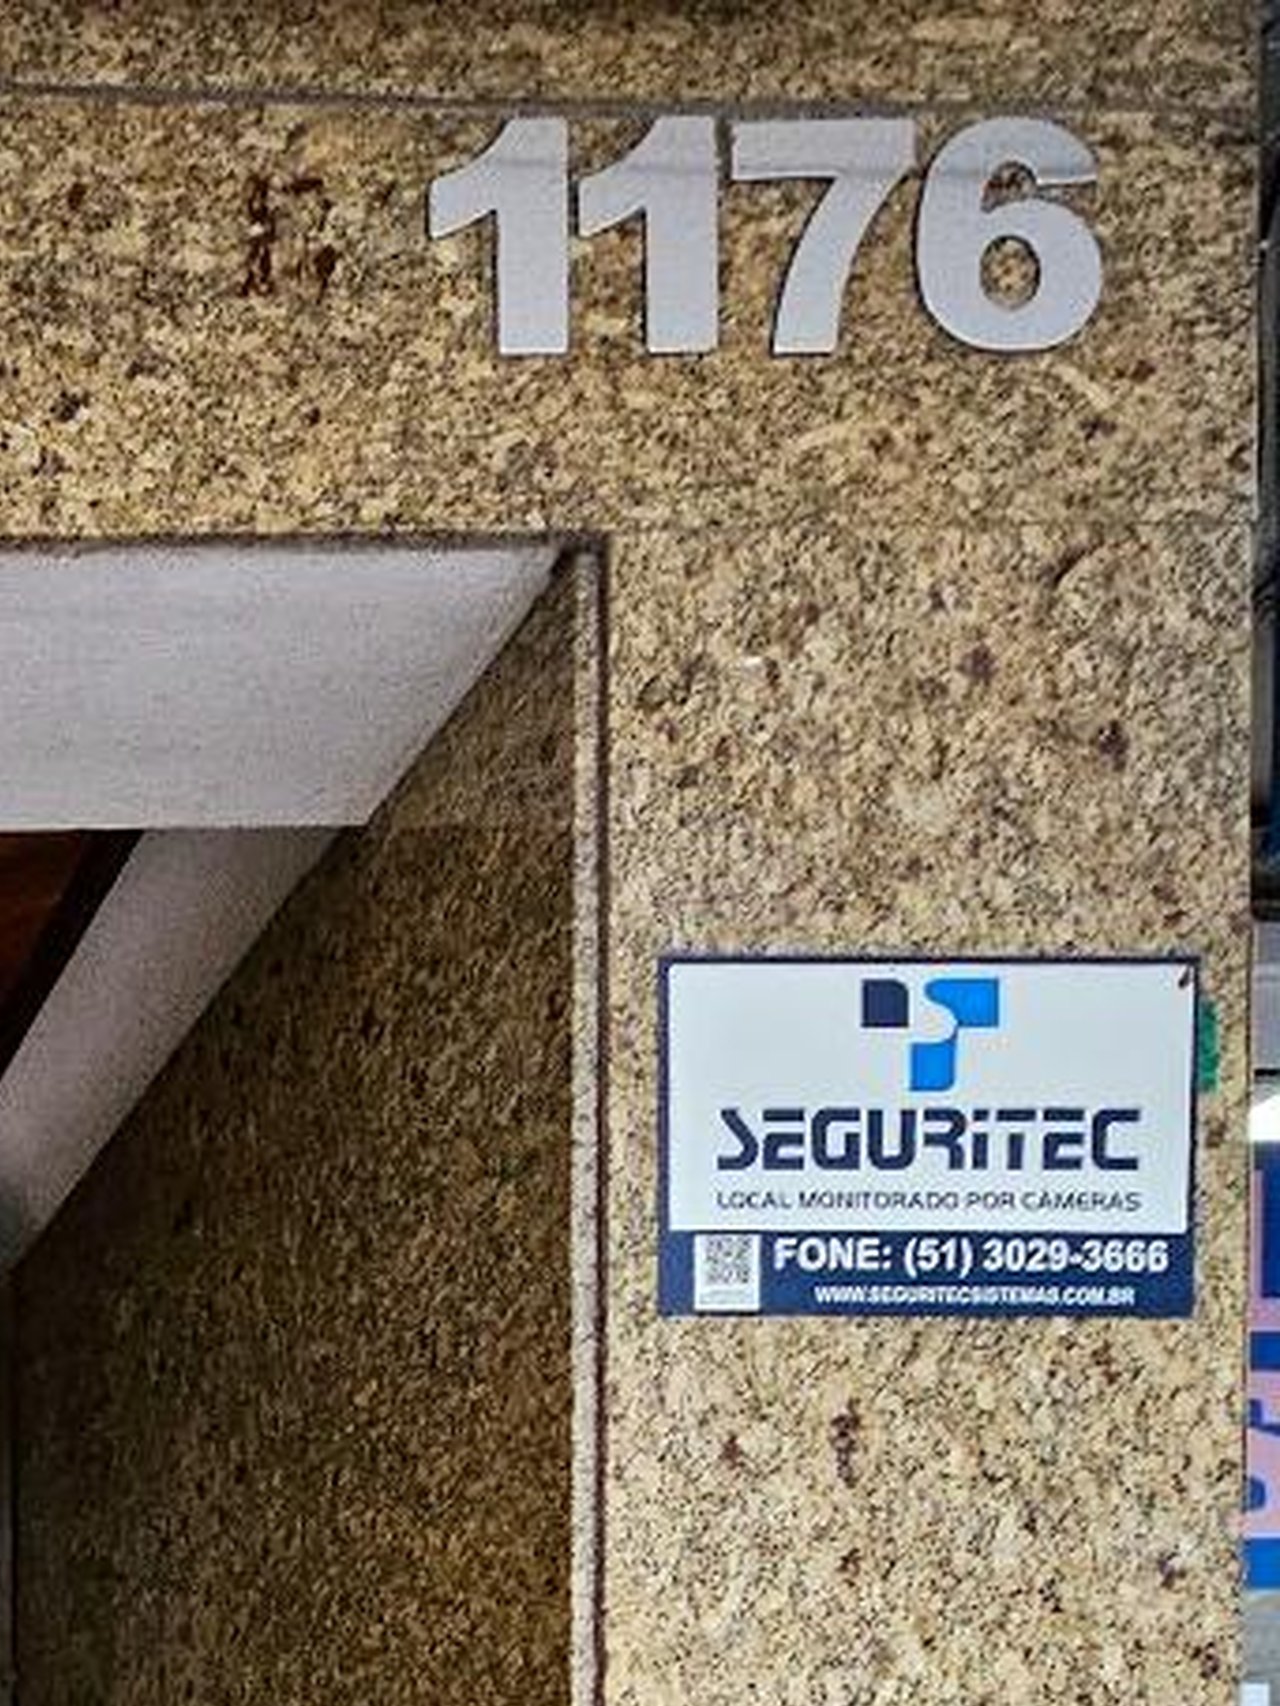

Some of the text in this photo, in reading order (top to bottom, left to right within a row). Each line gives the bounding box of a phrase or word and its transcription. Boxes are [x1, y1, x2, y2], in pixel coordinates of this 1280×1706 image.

[428, 115, 1103, 354] 1176
[716, 1107, 1140, 1172] SEGURITEC
[716, 1191, 791, 1211] LOCAL
[797, 1191, 960, 1212] MONITORADO
[965, 1191, 1015, 1211] POR
[773, 1237, 1169, 1278] FONE: (51) 3029-3666
